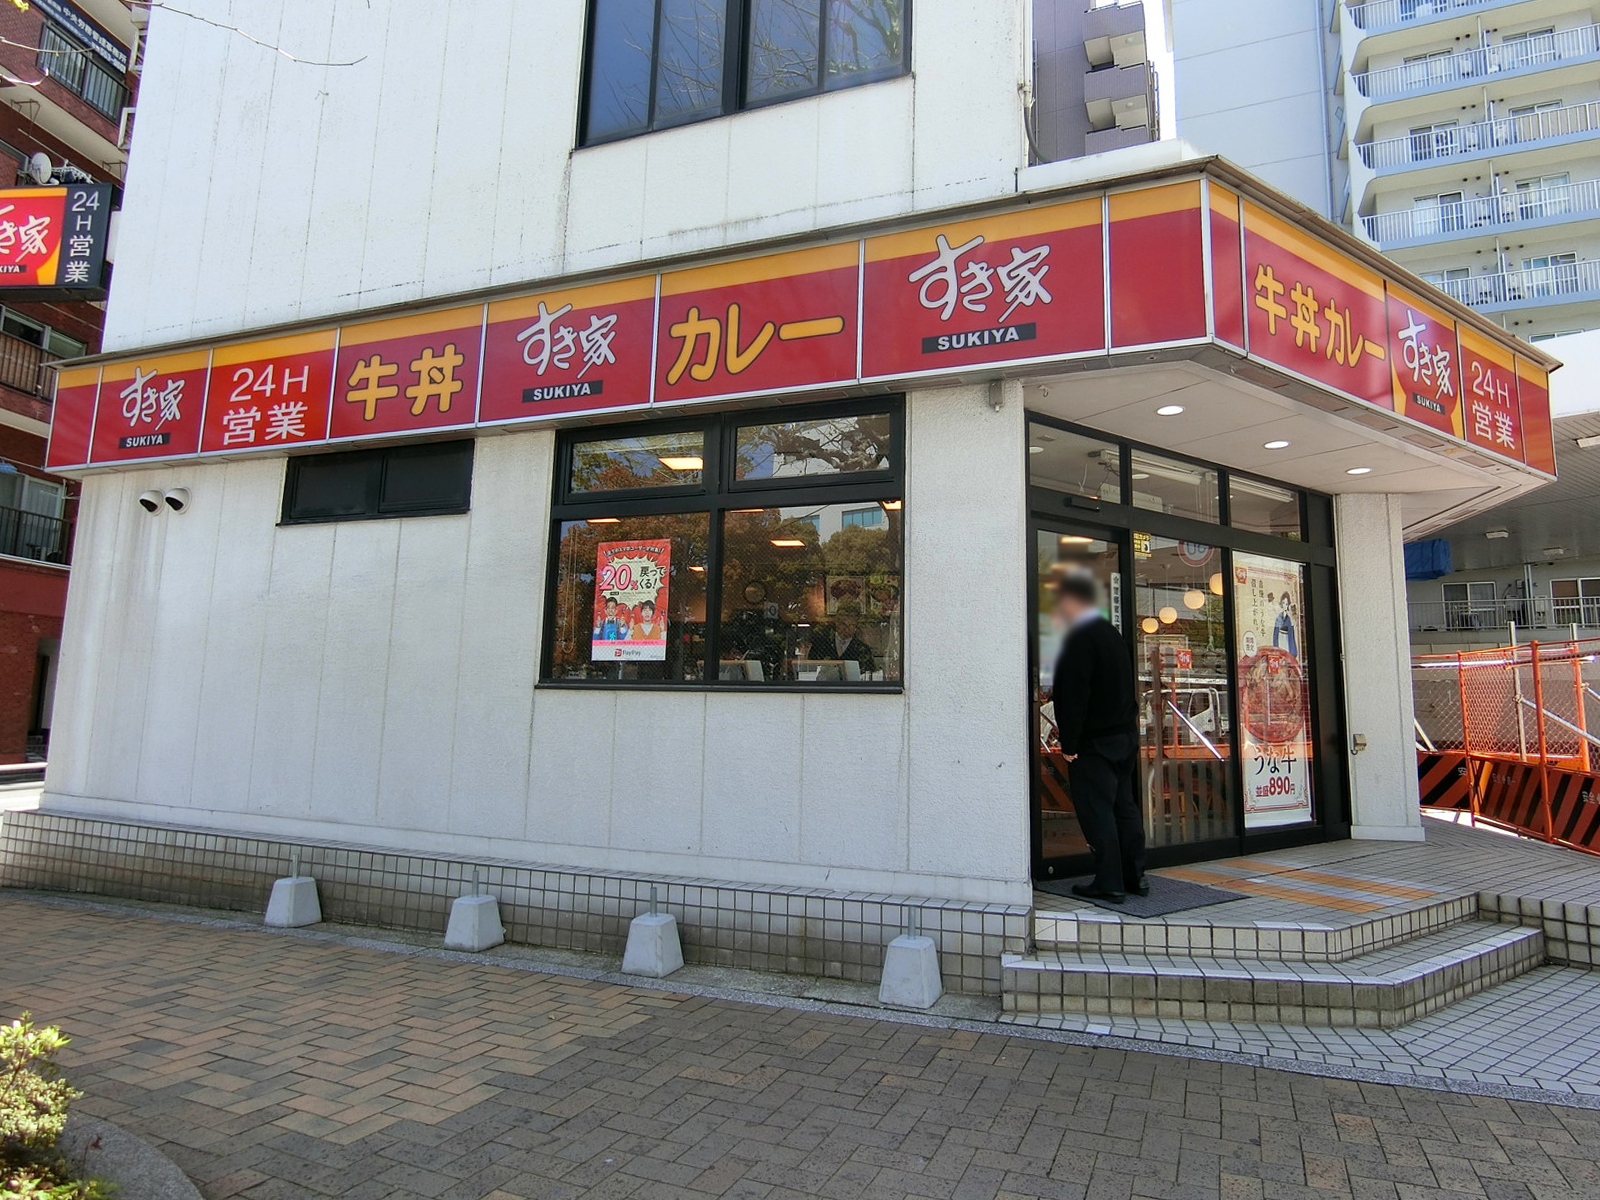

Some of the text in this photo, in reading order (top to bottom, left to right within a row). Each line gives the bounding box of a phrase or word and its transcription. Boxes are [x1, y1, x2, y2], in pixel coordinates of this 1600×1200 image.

[0, 205, 51, 263] き家
[907, 233, 1053, 323] すき家
[937, 326, 1020, 351] SUKIYA
[1254, 263, 1386, 368] 牛丼カレー
[516, 301, 618, 379] すき家
[665, 302, 845, 386] カレー
[1397, 308, 1454, 400] すき家
[119, 366, 186, 431] すき家
[229, 364, 309, 402] 24H
[346, 342, 465, 421] 牛丼
[533, 382, 591, 401] SUKIYA
[1416, 394, 1441, 413] SUKIYA
[1471, 360, 1510, 408] 24H
[126, 434, 163, 448] SUKIYA
[222, 401, 308, 445] 営業
[1472, 399, 1516, 450] 営業
[600, 564, 639, 591] 20%
[639, 578, 658, 589] くる!
[640, 566, 666, 577] 戻って
[1254, 745, 1297, 775] うな牛
